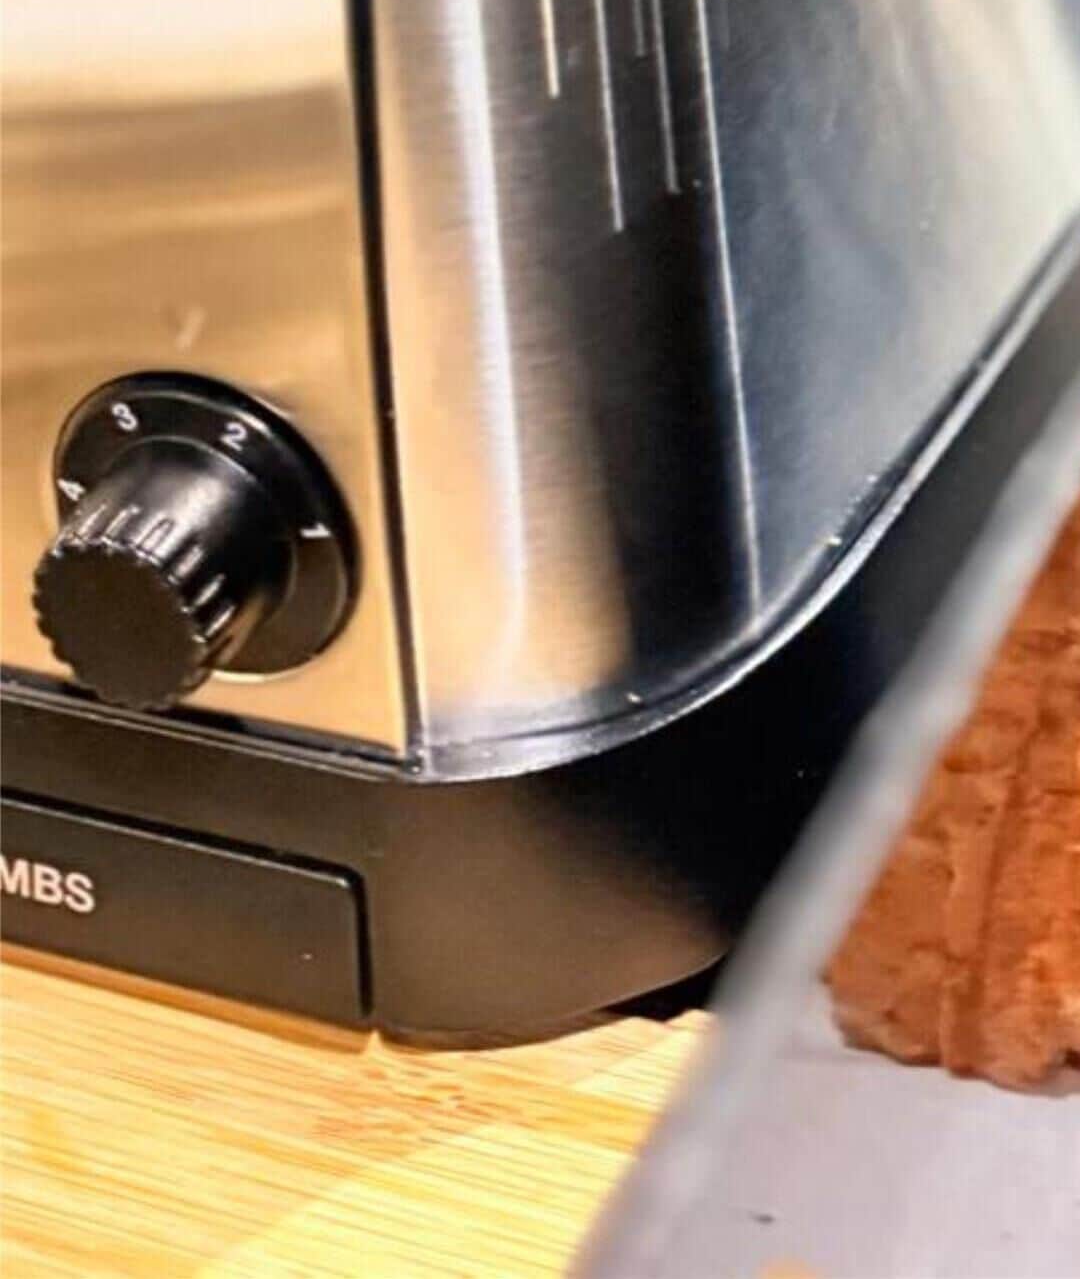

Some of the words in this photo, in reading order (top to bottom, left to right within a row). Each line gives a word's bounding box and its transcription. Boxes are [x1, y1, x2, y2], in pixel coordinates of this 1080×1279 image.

[111, 402, 138, 432] 3
[219, 421, 247, 451] 2
[57, 478, 86, 501] 4
[300, 522, 332, 539] 1
[0, 852, 95, 913] MBS
